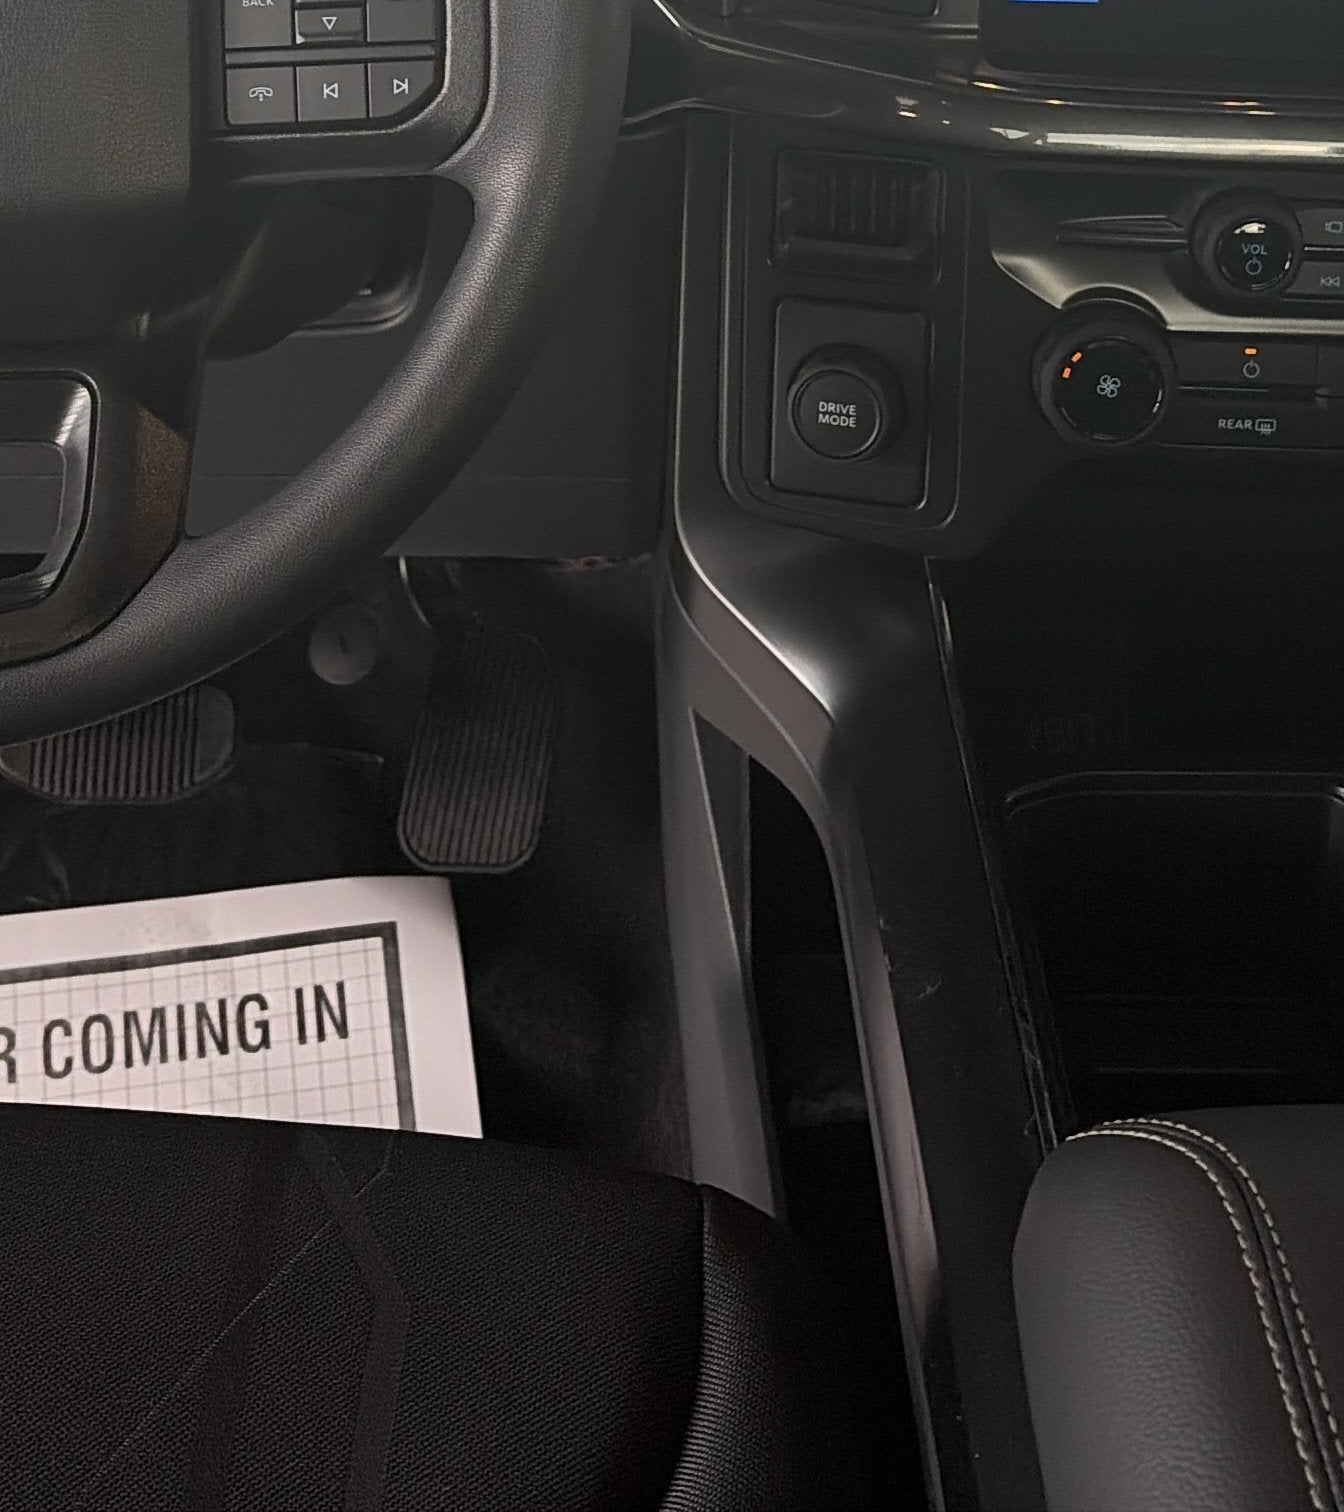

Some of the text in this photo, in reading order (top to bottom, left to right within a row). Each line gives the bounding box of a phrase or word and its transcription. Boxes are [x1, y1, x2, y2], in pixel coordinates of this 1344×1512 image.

[1241, 243, 1268, 255] VOL
[818, 401, 857, 416] DRIVE
[817, 413, 857, 428] MODE
[1218, 418, 1253, 430] REAR
[42, 992, 271, 1079] COMING
[294, 980, 349, 1045] IN
